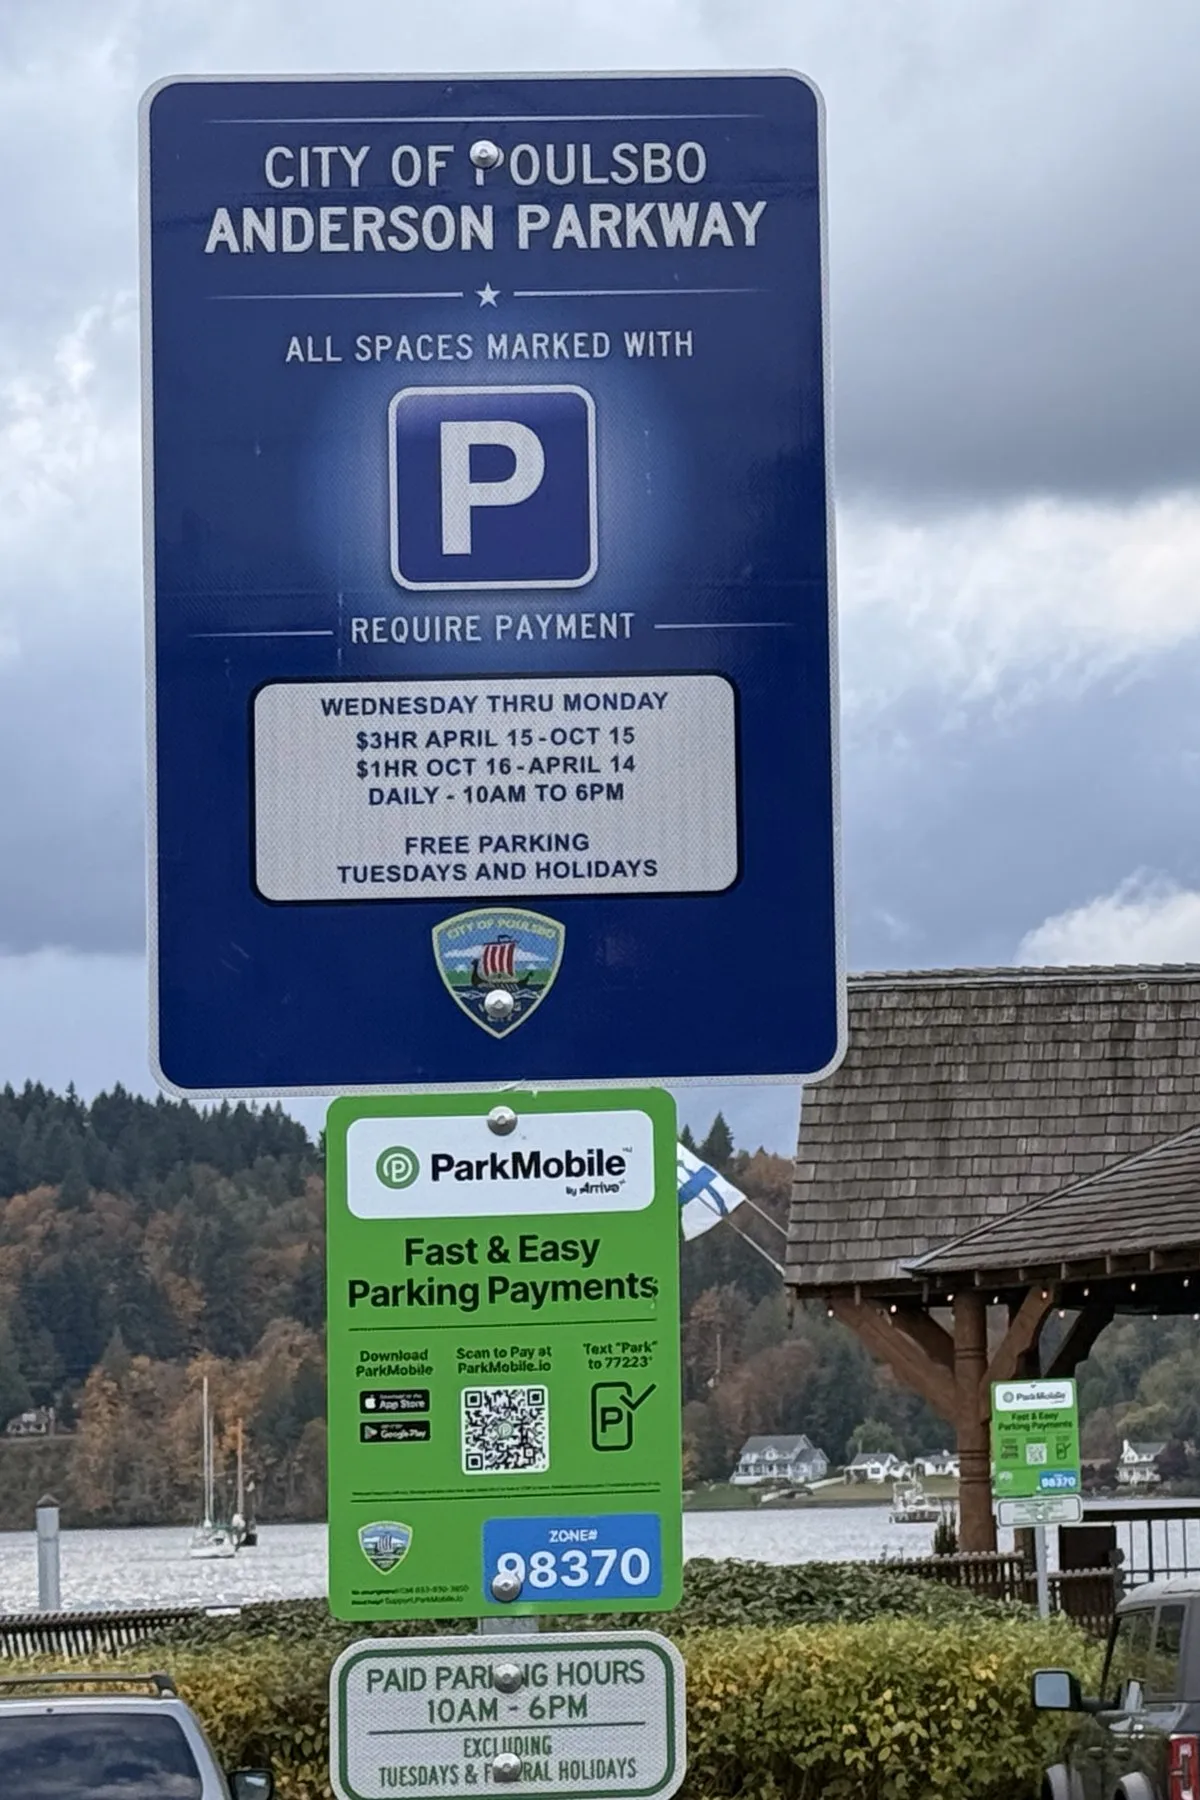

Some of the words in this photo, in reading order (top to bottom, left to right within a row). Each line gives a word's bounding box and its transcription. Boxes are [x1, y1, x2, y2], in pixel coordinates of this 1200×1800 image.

[265, 145, 370, 188] CITY
[391, 144, 454, 186] OF
[204, 204, 493, 254] ANDERSON
[518, 200, 766, 249] PARKWAY
[286, 335, 342, 363] ALL
[355, 333, 473, 362] SPACES
[487, 332, 610, 360] MARKED
[624, 330, 693, 357] WITH
[439, 420, 545, 556] P
[351, 614, 482, 644] REQUIRE
[495, 612, 635, 641] PAYMENT
[321, 696, 477, 717] WEDNESDAY
[489, 694, 554, 714] THRU
[564, 692, 669, 712] MONDAY
[356, 731, 418, 752] $3HR
[425, 729, 498, 749] APRIL
[610, 726, 636, 746] 15
[356, 760, 418, 780] $1HR
[426, 758, 476, 778] OCT
[610, 755, 636, 775] 14
[368, 787, 439, 807] DAILY
[463, 785, 526, 805] 10AM
[535, 784, 568, 803] TO
[575, 783, 624, 802] 6PM
[404, 836, 470, 857] FREE
[478, 832, 590, 855] PARKING
[337, 863, 468, 885] TUESDAYS
[475, 861, 526, 882] AND
[535, 858, 658, 881] HOLIDAYS
[477, 919, 495, 931] OF
[431, 1147, 627, 1182] ParkMobile
[404, 1238, 478, 1266] Fast
[487, 1235, 510, 1264] &
[519, 1234, 600, 1268] Easy
[348, 1277, 479, 1312] Parking
[488, 1272, 659, 1312] Payments
[360, 1348, 428, 1362] Download
[456, 1347, 490, 1360] Scan
[493, 1347, 507, 1359] to
[511, 1346, 535, 1360] Pay
[539, 1345, 552, 1357] at
[583, 1342, 613, 1355] Text
[356, 1364, 434, 1377] ParkMobile
[458, 1360, 551, 1374] ParkMobile.io
[588, 1358, 602, 1369] to
[496, 1547, 651, 1590] 98370
[366, 1668, 427, 1693] PAID
[435, 1663, 548, 1690] PARNG
[557, 1660, 646, 1686] HOURS
[427, 1698, 498, 1725] 10AM
[529, 1693, 588, 1719] 6PM
[463, 1735, 552, 1758] EXCLUDING
[379, 1764, 459, 1788] TUESDAYS
[465, 1764, 478, 1785] &
[484, 1760, 553, 1784] FRAL
[558, 1757, 637, 1781] HOLIDAYS
